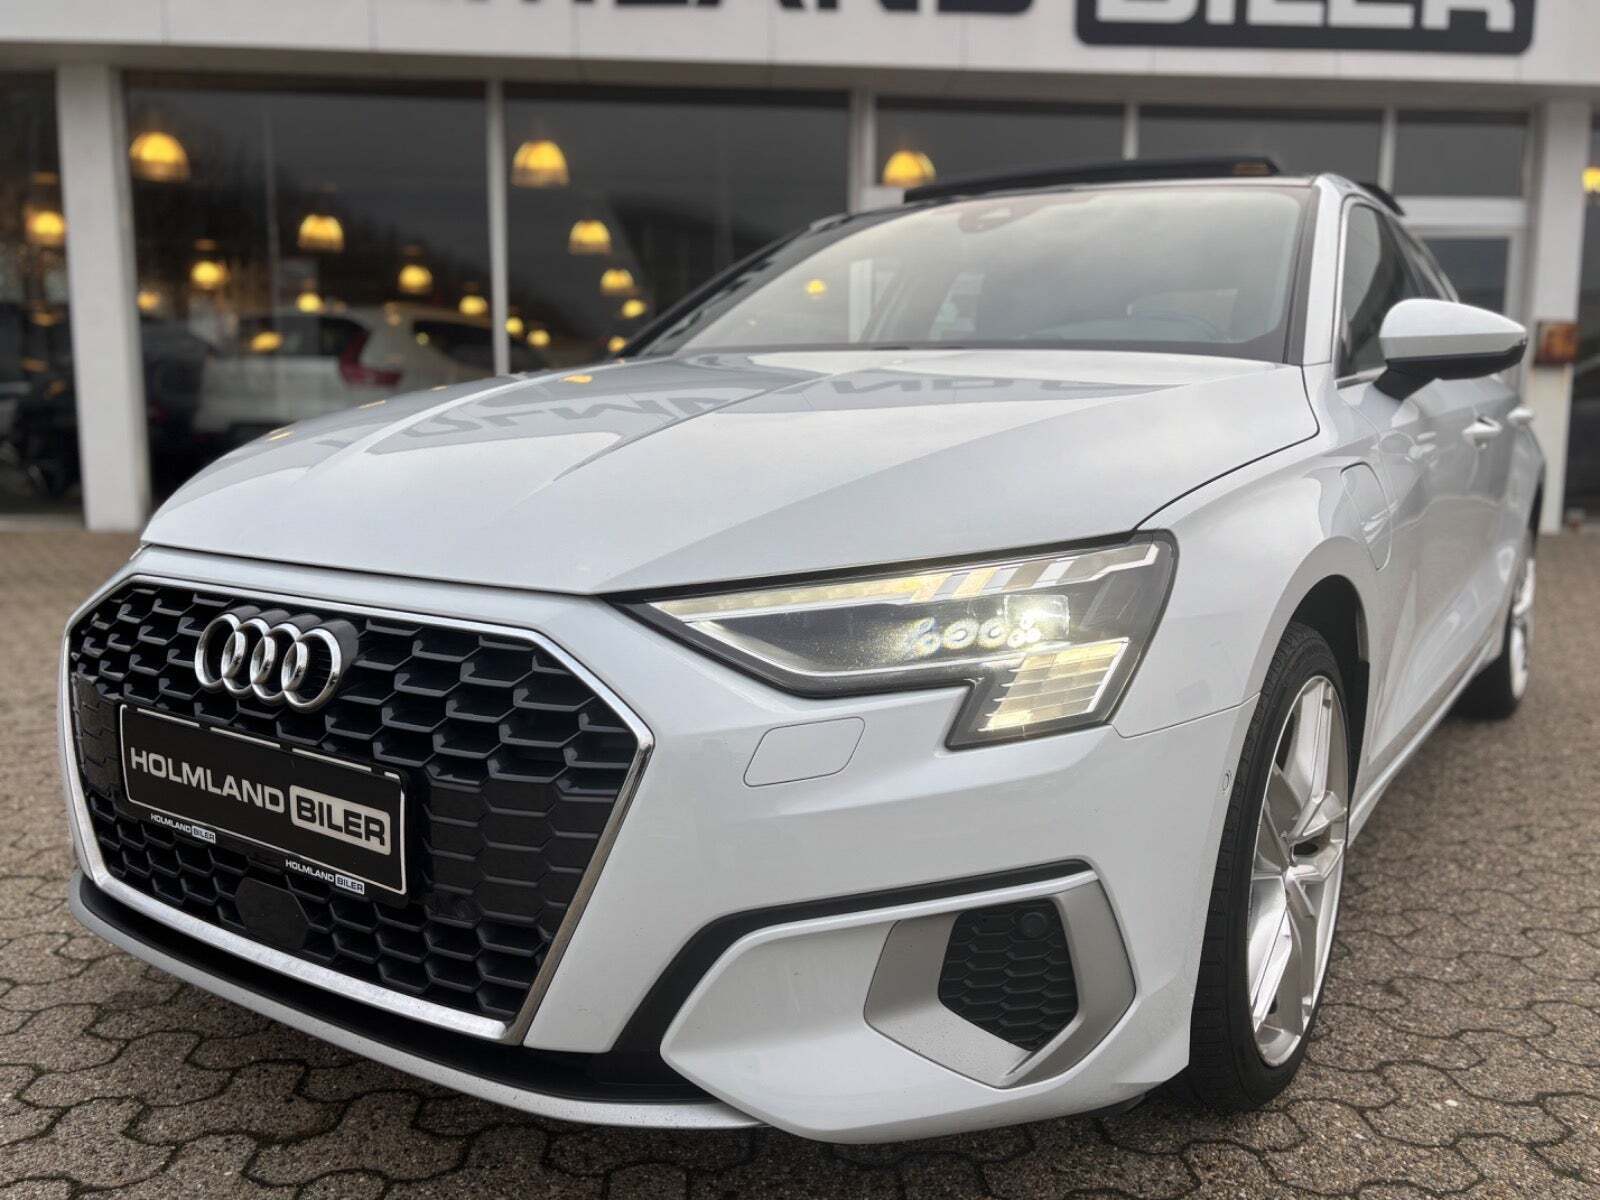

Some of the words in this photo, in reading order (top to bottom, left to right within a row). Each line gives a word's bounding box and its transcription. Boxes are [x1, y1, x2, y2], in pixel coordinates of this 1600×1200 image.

[130, 747, 285, 814] HOLMLAND
[296, 795, 385, 847] BILER
[150, 813, 192, 833] HOLMLAND
[285, 859, 334, 883] HOLMLAND
[337, 875, 364, 892] BILER
